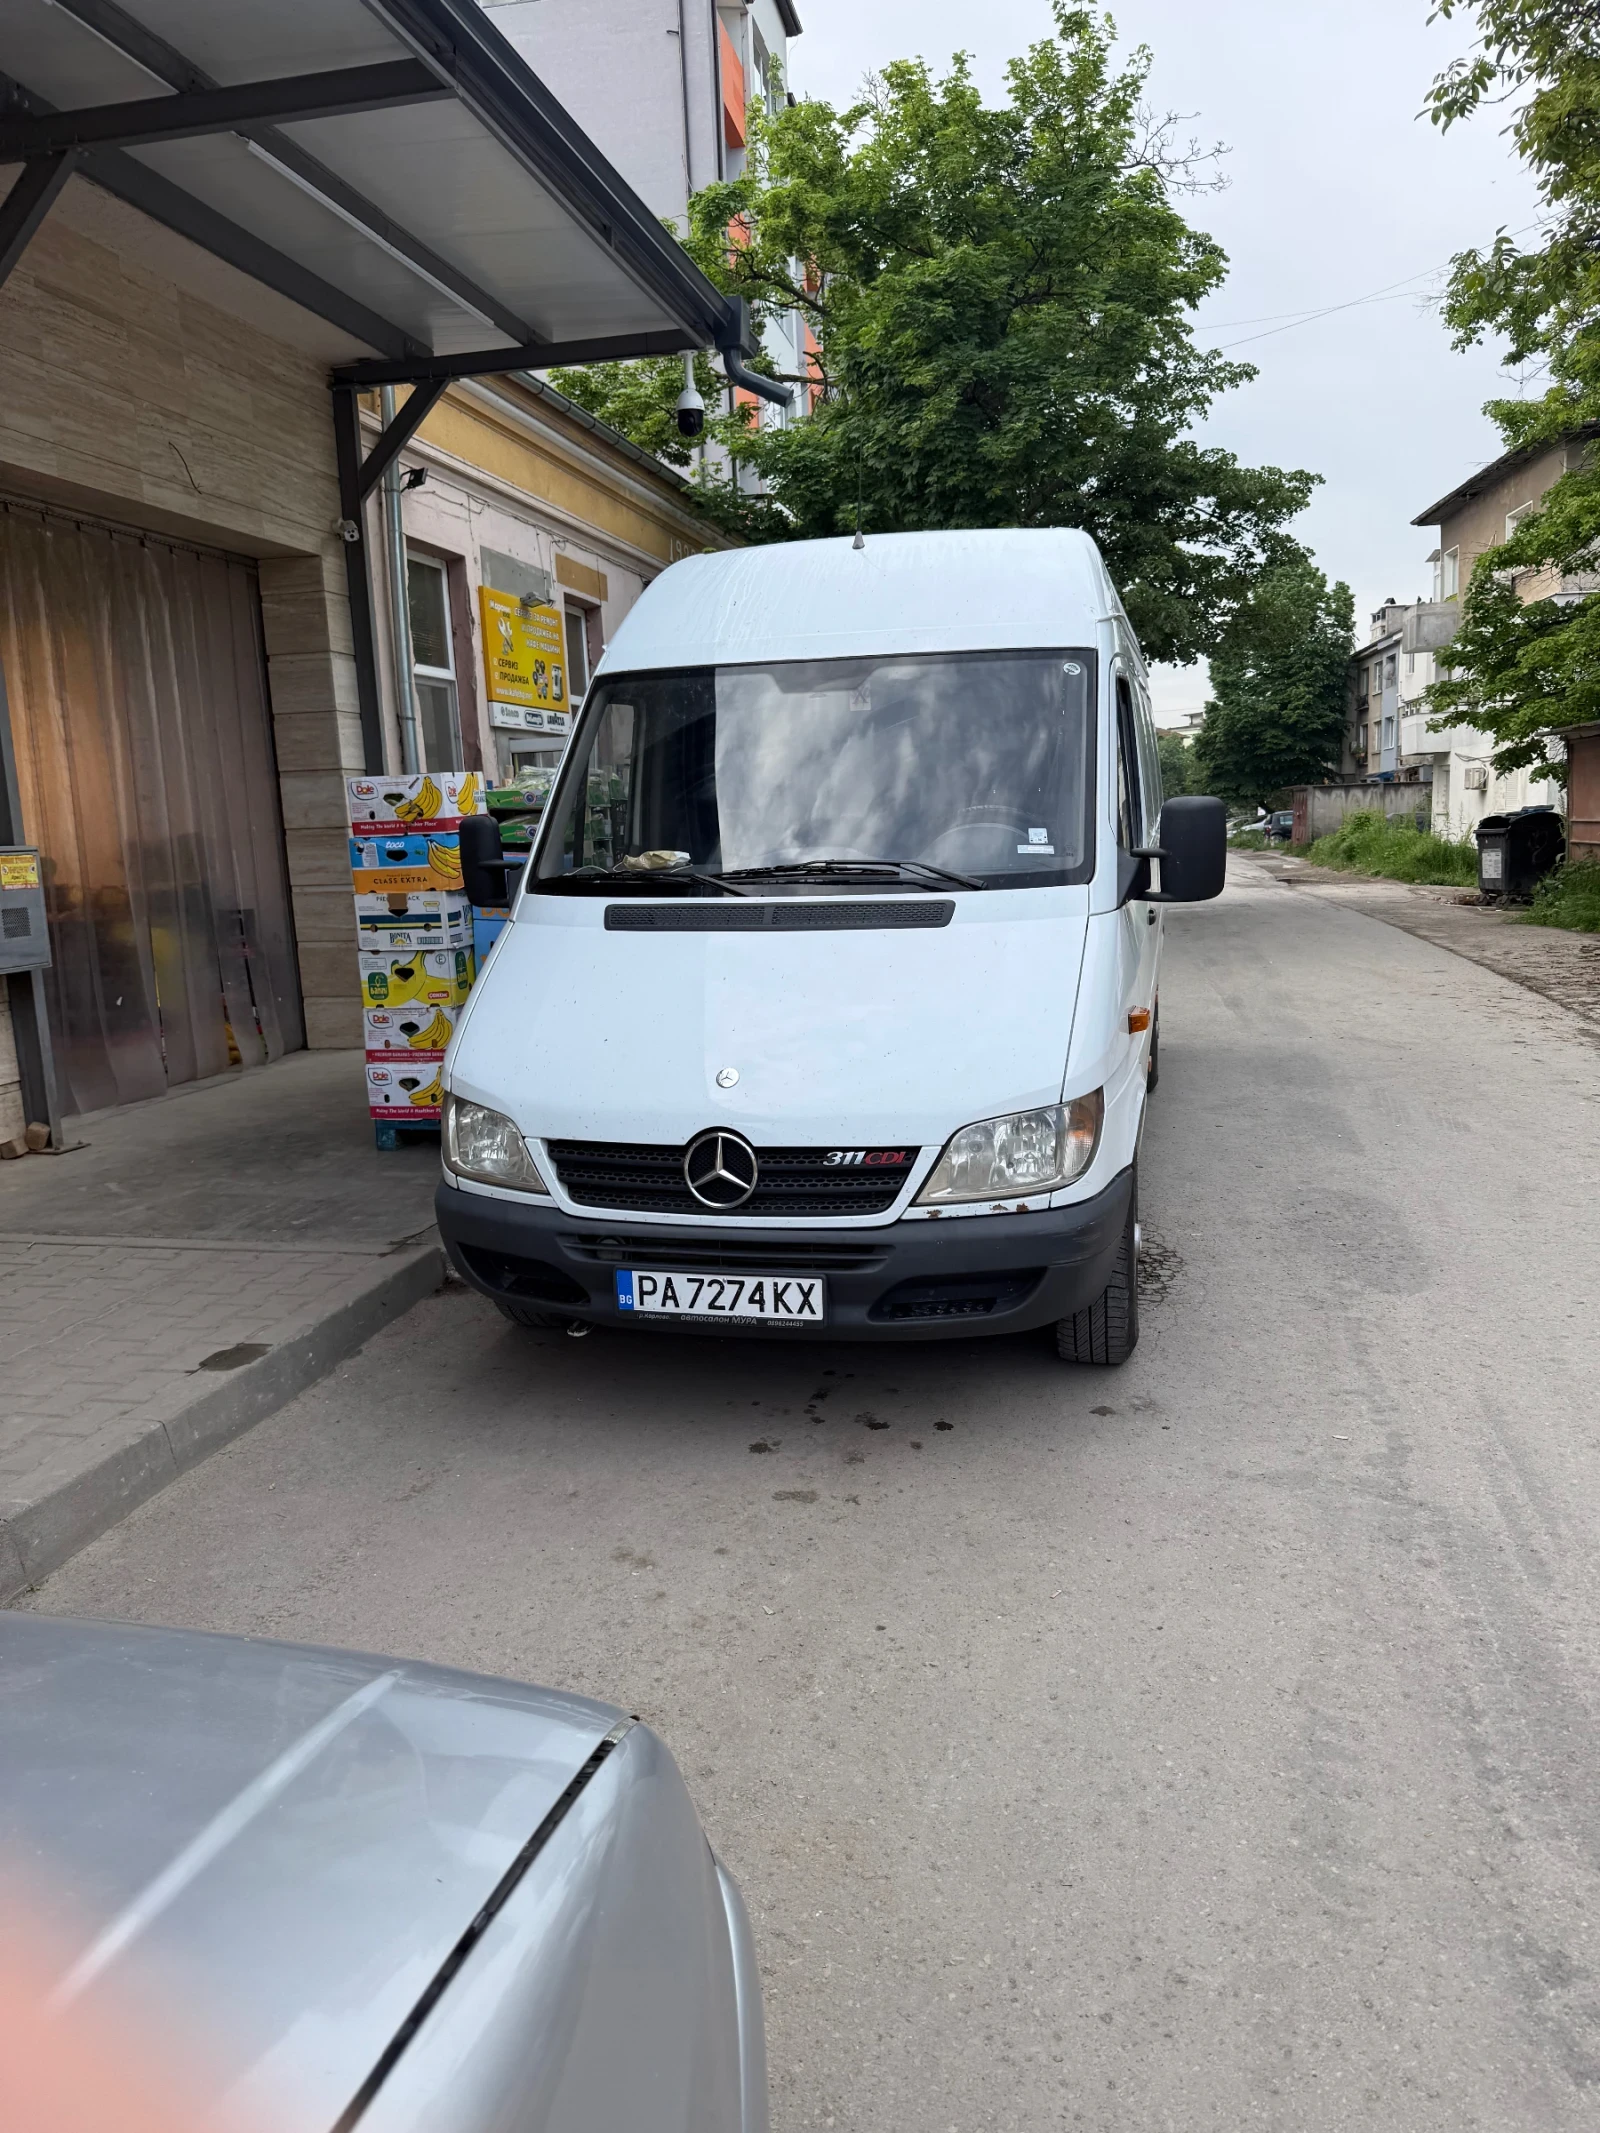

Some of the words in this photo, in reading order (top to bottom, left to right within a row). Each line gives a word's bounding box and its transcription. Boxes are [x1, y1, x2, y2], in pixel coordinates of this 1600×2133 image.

[540, 615, 558, 627] РЕМОНТ
[540, 642, 561, 654] МАШИНИ
[498, 658, 519, 671] СЕРВИЗ
[499, 671, 530, 686] ПРОДАЖБА
[356, 785, 375, 795] Dole
[401, 876, 428, 884] EXTRA
[373, 1015, 390, 1023] Dole
[373, 1072, 389, 1080] Dole
[619, 1295, 632, 1304] BG
[680, 1314, 730, 1324] автосалон
[731, 1316, 758, 1326] МУРА
